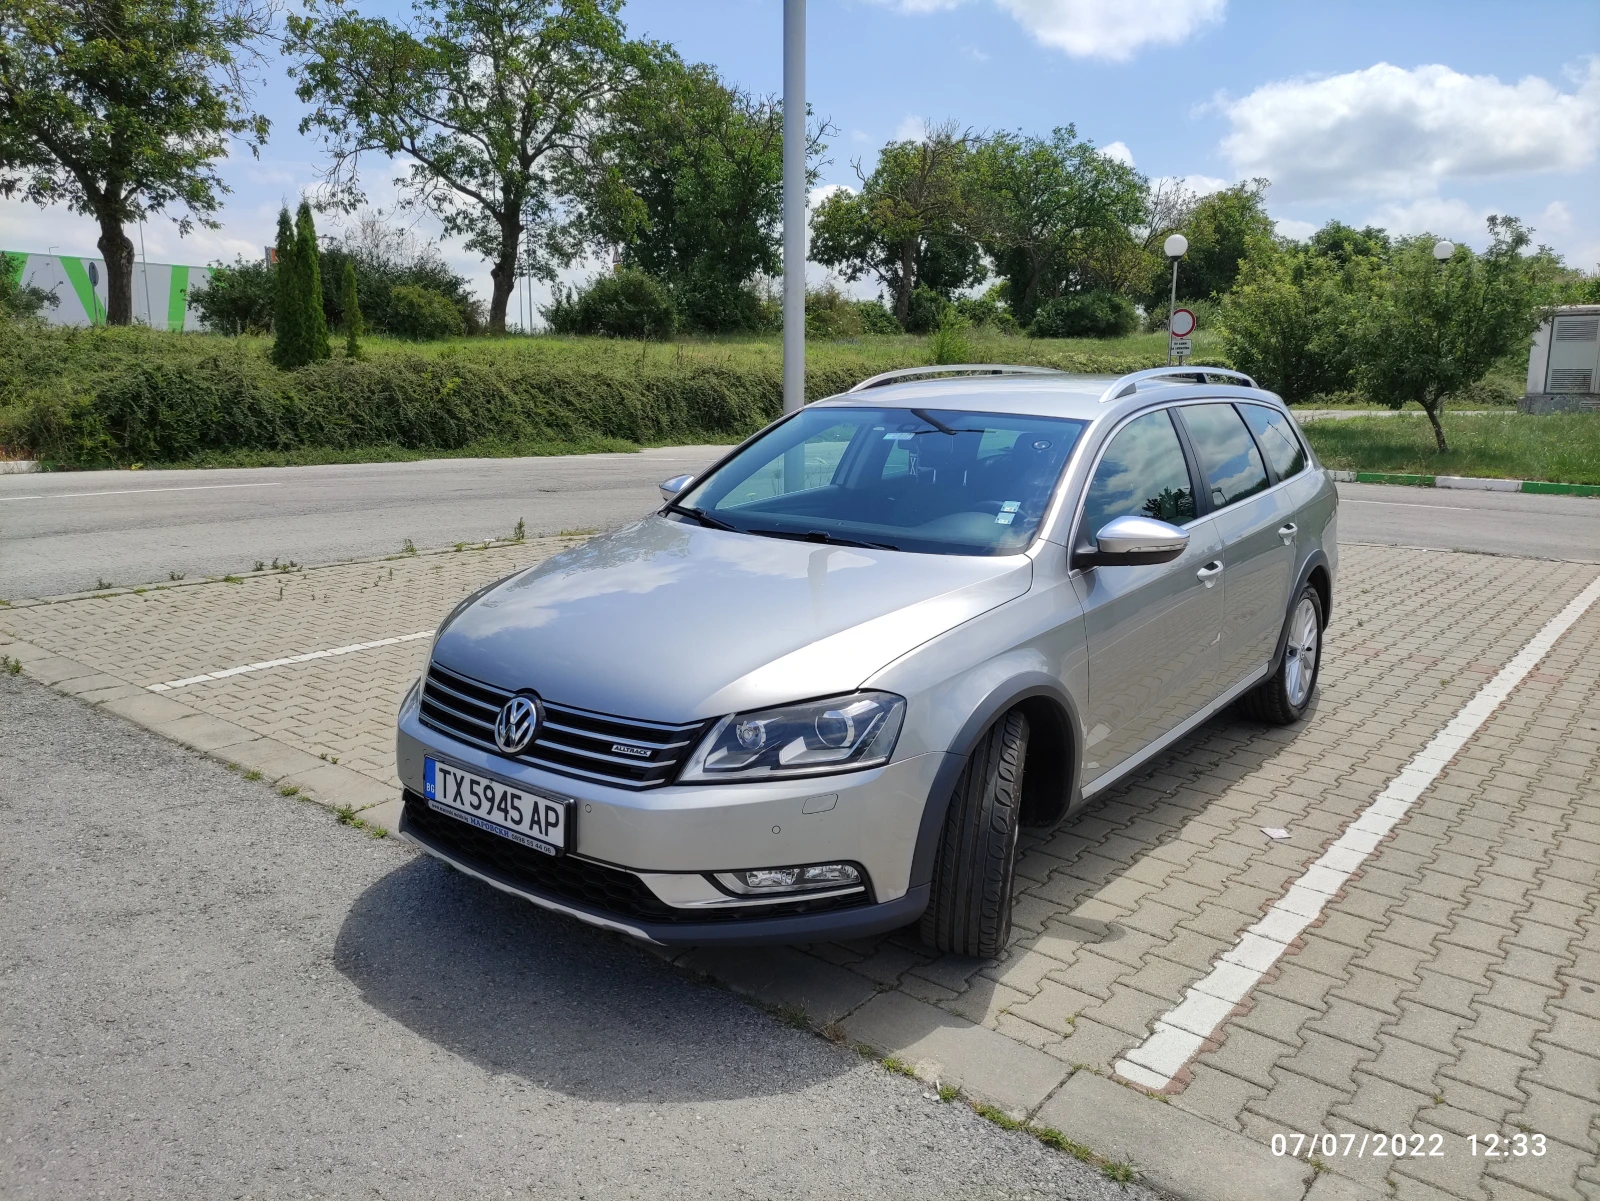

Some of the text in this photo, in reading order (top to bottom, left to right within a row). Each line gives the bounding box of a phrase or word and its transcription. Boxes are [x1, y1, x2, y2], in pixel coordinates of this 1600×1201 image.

[613, 745, 649, 756] ALLTRACK
[426, 782, 435, 794] BG
[529, 800, 560, 837] AP
